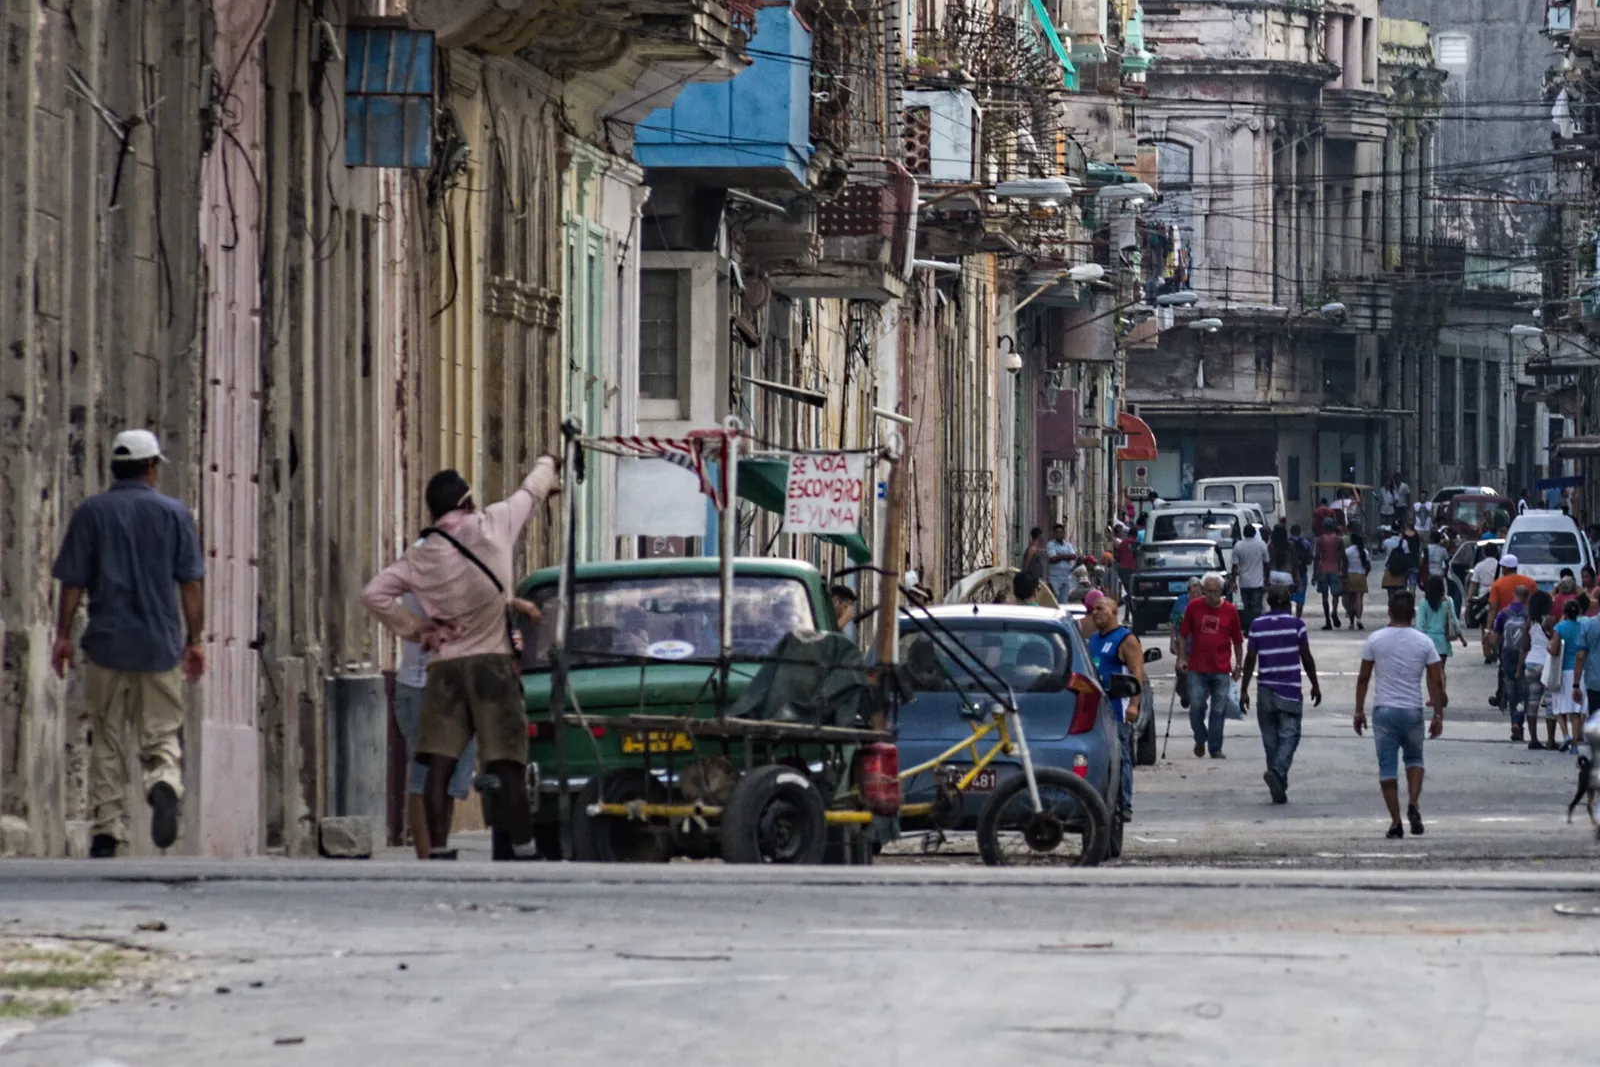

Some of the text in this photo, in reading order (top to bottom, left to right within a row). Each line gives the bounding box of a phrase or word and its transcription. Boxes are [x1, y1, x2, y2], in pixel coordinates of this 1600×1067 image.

[792, 453, 848, 475] SE VOTA
[788, 478, 862, 502] ESCOMBRO
[790, 504, 854, 528] EL YUMA
